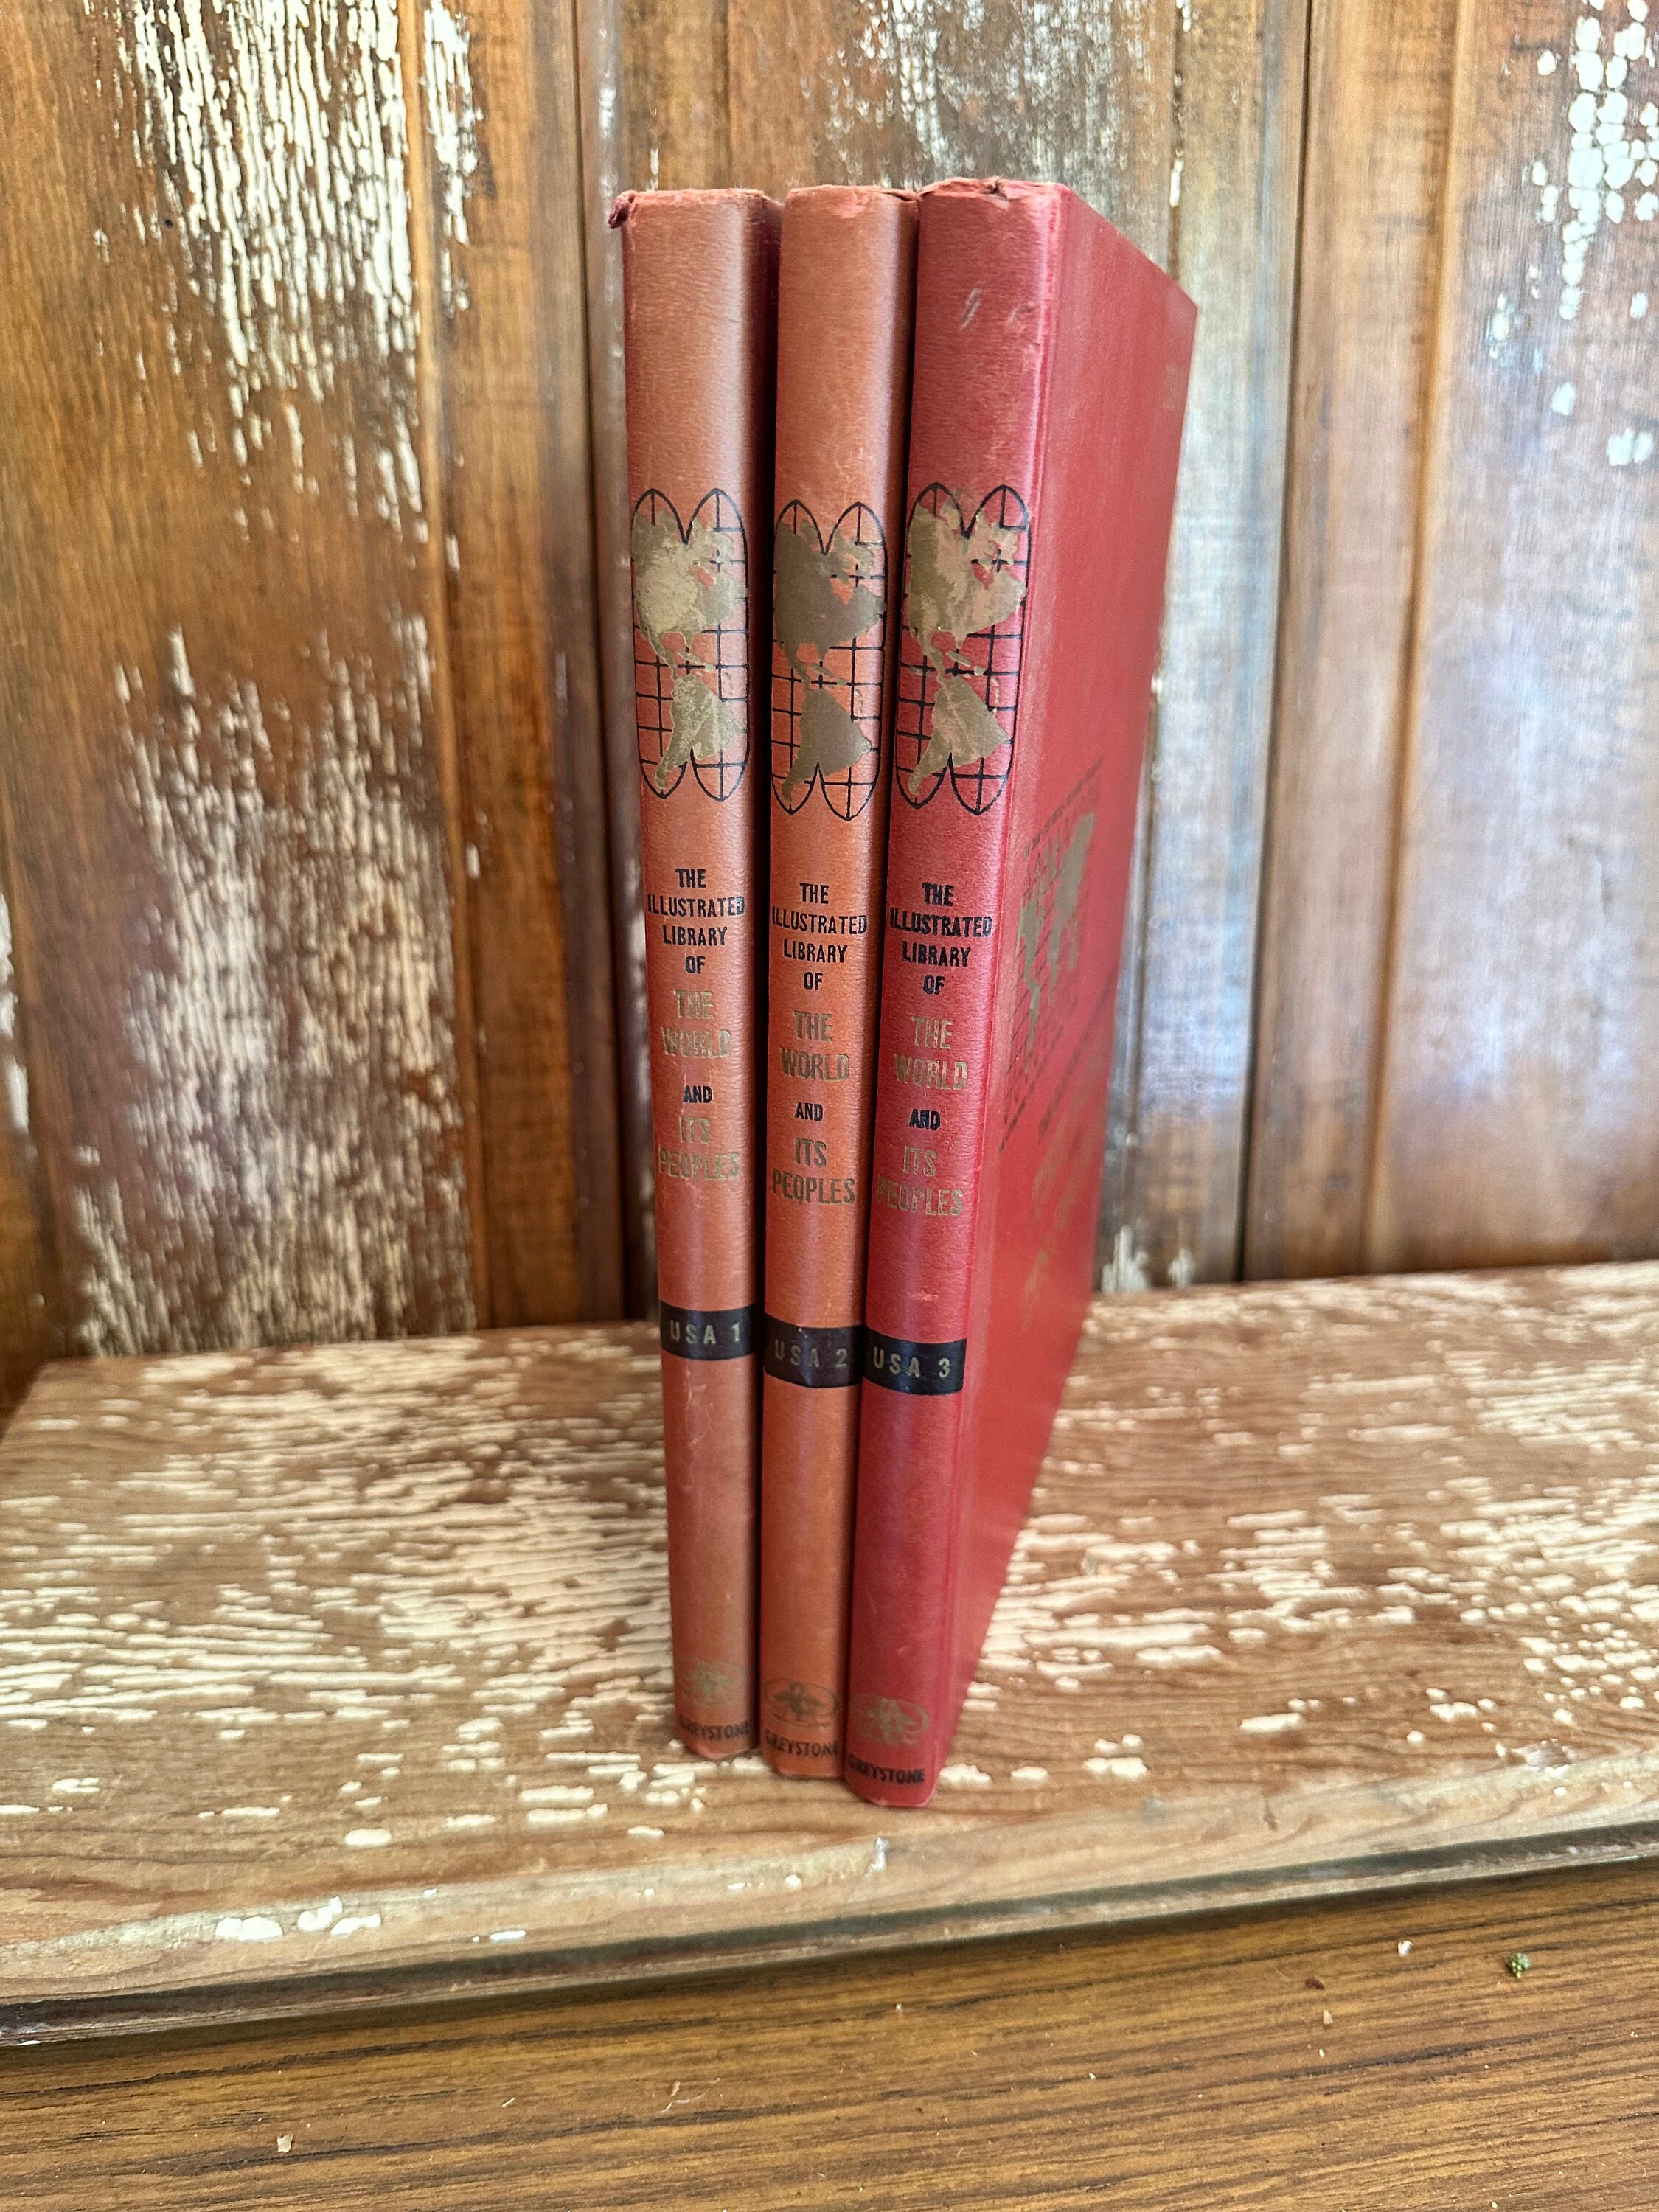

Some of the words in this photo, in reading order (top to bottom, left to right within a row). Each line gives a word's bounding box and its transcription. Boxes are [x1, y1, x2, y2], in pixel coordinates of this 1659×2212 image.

[675, 868, 706, 888] THE
[647, 894, 745, 918] ILLUSTRATED
[799, 883, 829, 904] THE
[922, 882, 953, 906] THE
[771, 905, 867, 936] ILLUSTRATED
[890, 908, 992, 938] ILLUSTRATED
[663, 925, 728, 946] LIBRARY
[685, 956, 706, 974] OF
[783, 939, 848, 964] LIBRARY
[902, 941, 971, 968] LIBRARY
[803, 971, 824, 990] OF
[922, 975, 945, 995] OF
[672, 989, 714, 1019] THE
[793, 1010, 833, 1043] THE
[911, 1016, 953, 1050] THE
[661, 1026, 731, 1058] WORLD
[779, 1048, 850, 1082] WORLD
[894, 1054, 967, 1091] WORLD
[683, 1085, 713, 1104] AND
[794, 1102, 824, 1121] AND
[909, 1109, 941, 1130] AND
[678, 1116, 712, 1144] ITS
[658, 1148, 740, 1180] PEOPLES
[795, 1138, 827, 1168] ITS
[902, 1146, 938, 1178] ITS
[773, 1169, 855, 1205] PEOPLES
[876, 1180, 964, 1216] PEOPLES
[669, 1319, 717, 1345] USA
[731, 1322, 741, 1341] 1
[775, 1339, 820, 1368] USA
[835, 1348, 848, 1368] 2
[873, 1346, 921, 1377] USA
[939, 1357, 950, 1378] 3
